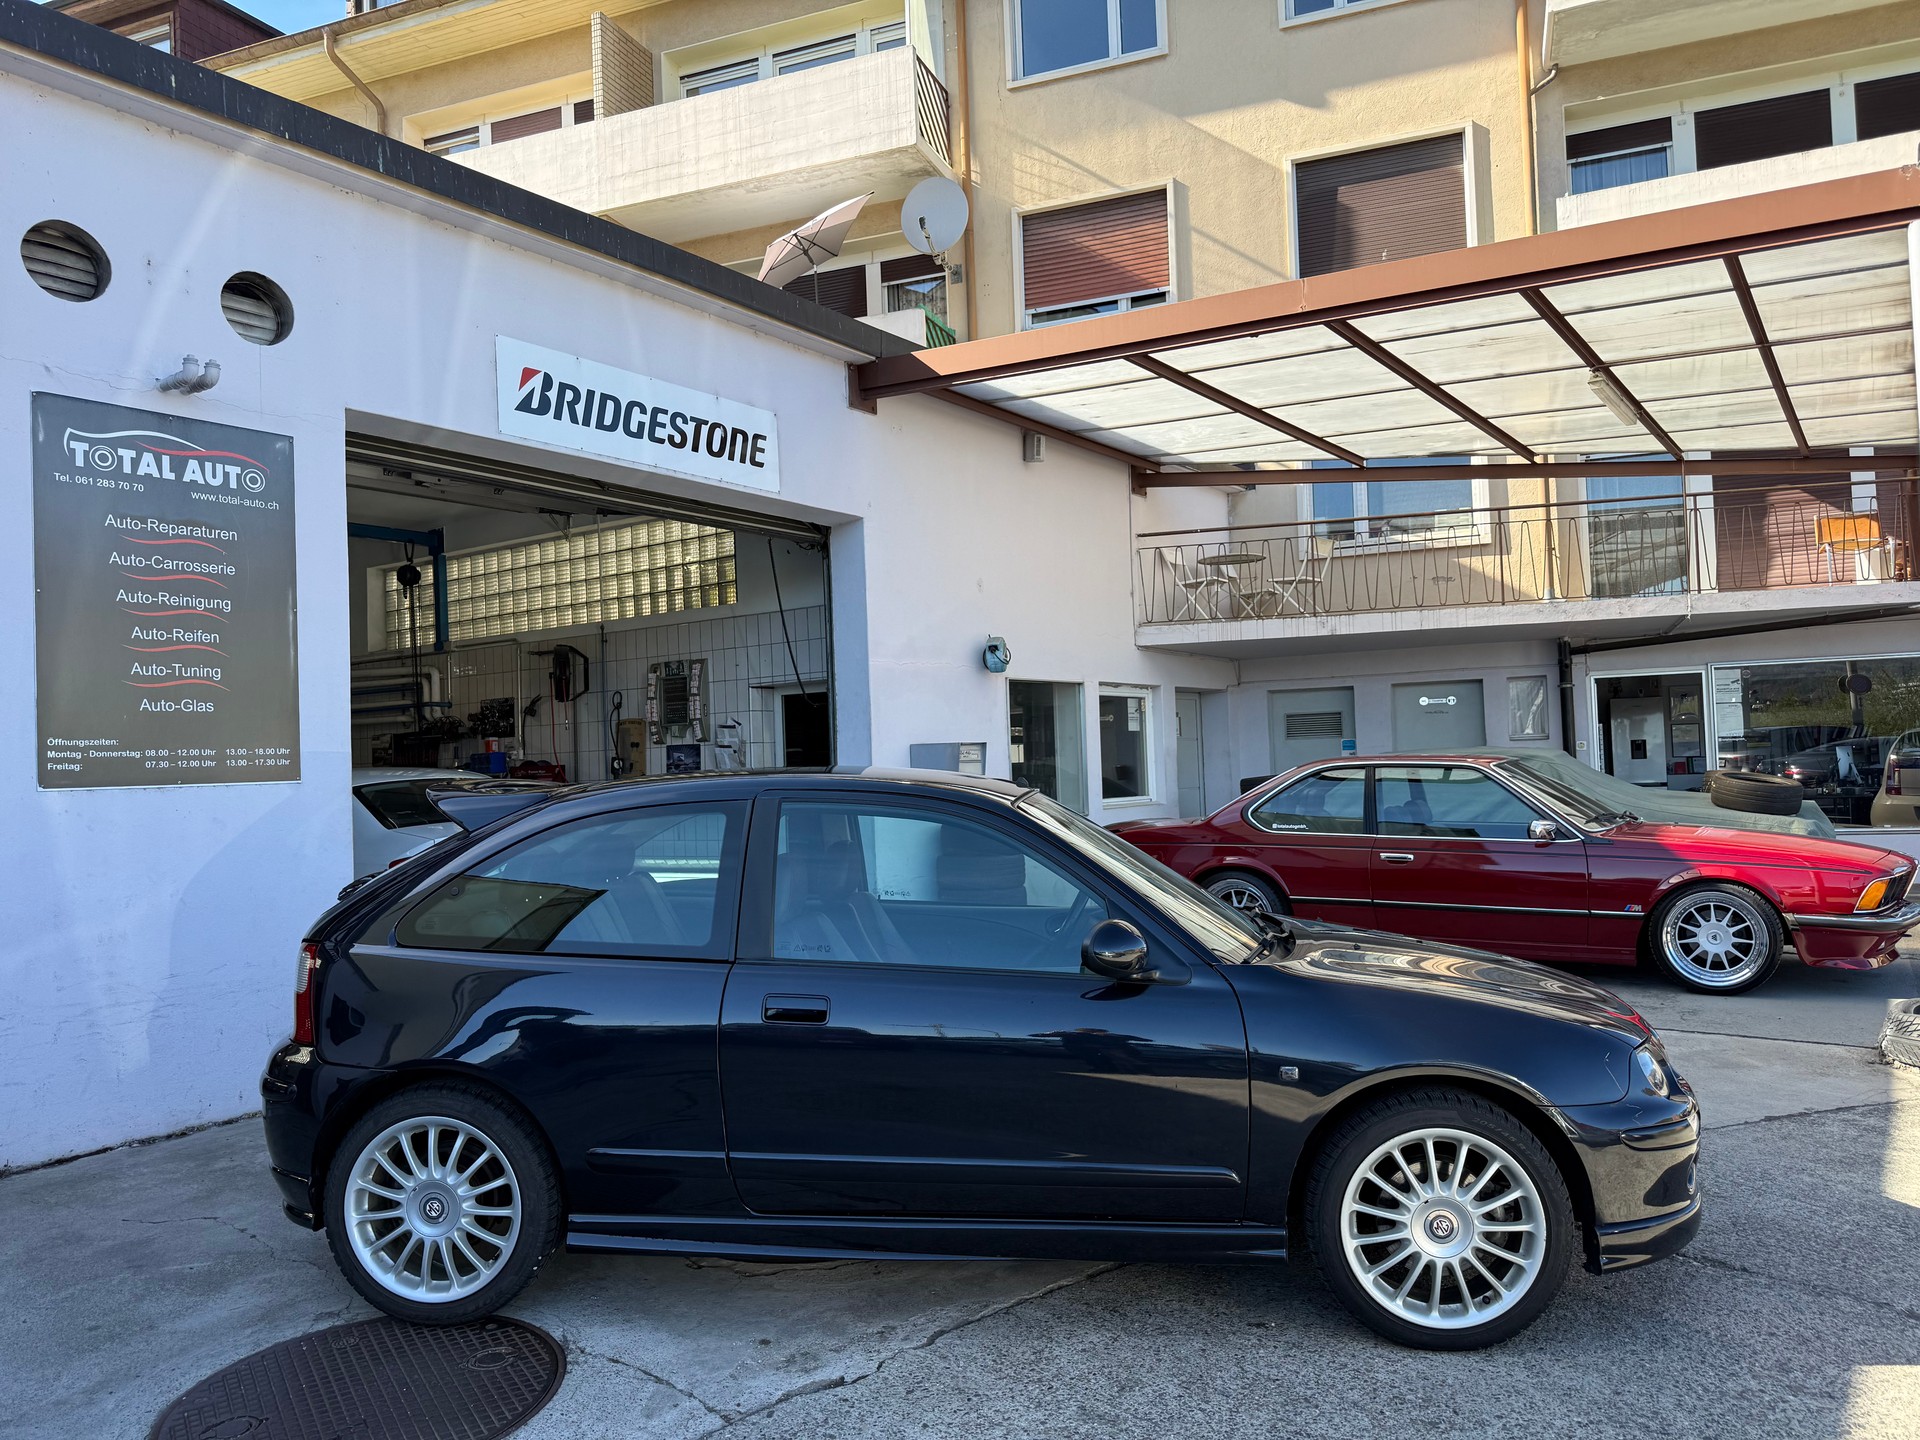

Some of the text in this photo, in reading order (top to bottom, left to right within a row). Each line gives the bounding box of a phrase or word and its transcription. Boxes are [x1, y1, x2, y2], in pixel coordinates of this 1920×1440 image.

[514, 367, 767, 468] BRIDGESTONE
[69, 440, 266, 492] TOTAL AUTO
[53, 472, 144, 492] Tel. 061 283 70 70
[191, 491, 280, 510] www.total-auto.ch
[104, 513, 238, 541] Auto-Reparaturen
[109, 551, 236, 576] Auto-Carrosserie
[116, 589, 231, 612] Auto-Reinigung
[131, 626, 220, 643] Auto-Reifen
[130, 662, 221, 681] Auto-Tuning
[139, 698, 215, 712] Auto-Glas
[47, 737, 119, 748] Öffnungszeiten:
[47, 750, 82, 760] Montag
[89, 749, 144, 759] Donnerstag:
[145, 749, 169, 757] 08.00
[177, 748, 200, 756] 12.00
[201, 748, 217, 756] Uhr
[254, 747, 275, 755] 18.00
[276, 747, 291, 755] Uhr
[47, 762, 83, 771] Freitag:
[145, 760, 169, 768] 07.30
[201, 759, 217, 767] Uhr
[254, 758, 276, 766] 17.30
[276, 758, 291, 766] Uhr
[427, 1200, 442, 1217] MG
[1433, 1218, 1451, 1236] MG
